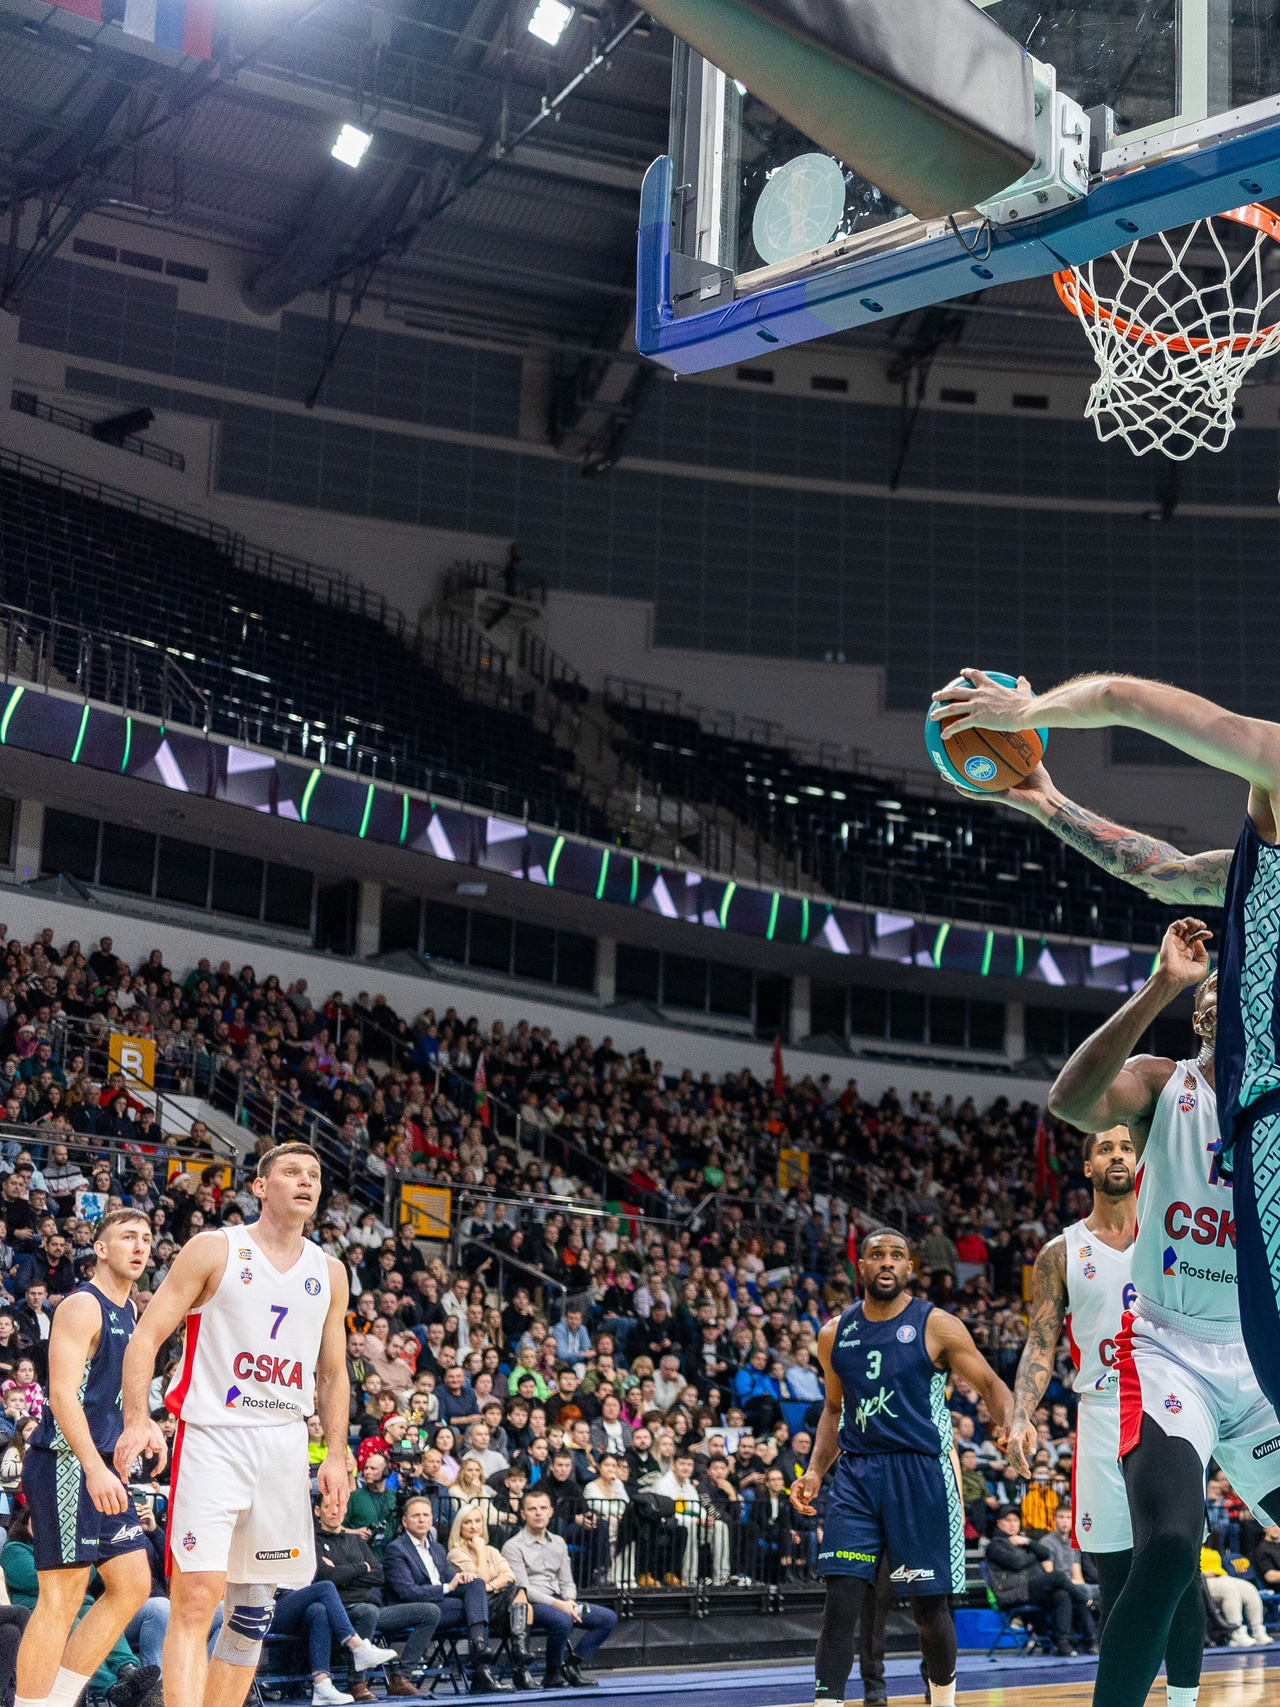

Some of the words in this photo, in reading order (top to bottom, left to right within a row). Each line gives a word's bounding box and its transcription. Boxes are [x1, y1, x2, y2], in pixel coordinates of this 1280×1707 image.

[120, 1048, 144, 1082] B
[1164, 1201, 1237, 1249] CSK
[1121, 1282, 1139, 1311] 6
[269, 1304, 289, 1340] 7
[839, 1340, 861, 1348] Kempa
[233, 1351, 303, 1390] CSKA
[865, 1350, 882, 1380] 3
[258, 1551, 289, 1561] Winline
